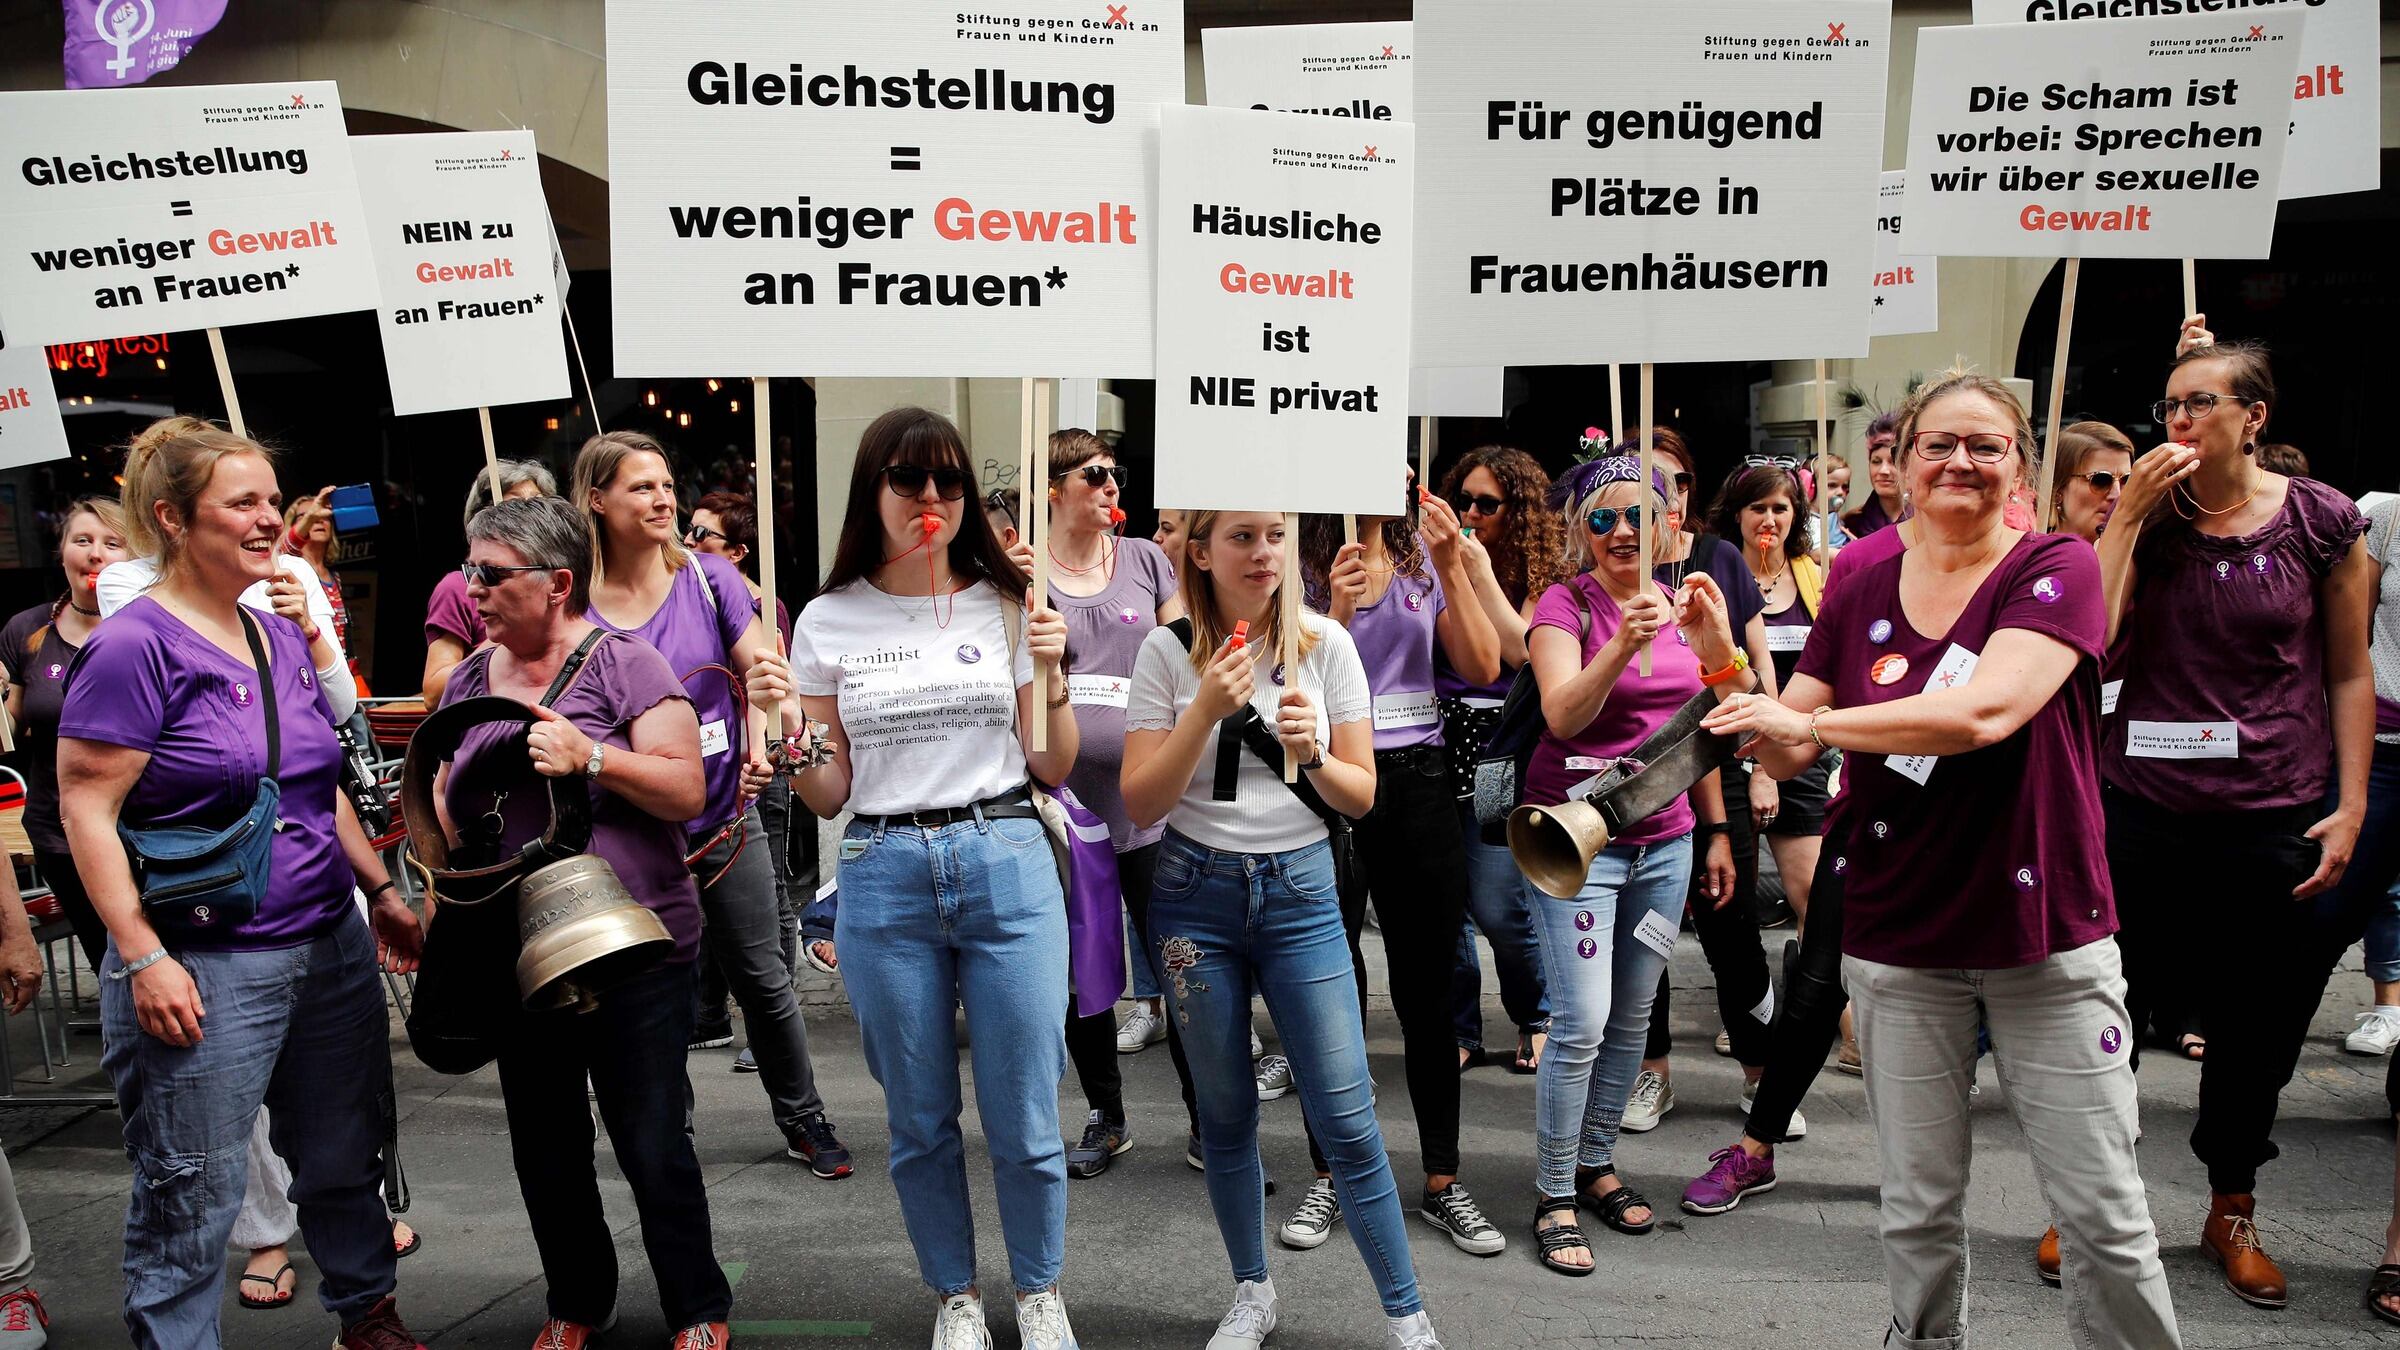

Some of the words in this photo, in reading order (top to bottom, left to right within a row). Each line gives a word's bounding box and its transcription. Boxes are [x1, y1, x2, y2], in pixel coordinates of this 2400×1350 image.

[957, 14, 1020, 27] Stiftung
[1028, 19, 1073, 29] gegen
[160, 41, 179, 54] jui
[957, 29, 1010, 40] Frauen
[1019, 33, 1045, 41] und
[1054, 33, 1113, 44] Kindern
[1705, 36, 1756, 47] Stiftung
[1763, 39, 1800, 48] gegen
[1705, 51, 1748, 60] Frauen
[1755, 51, 1776, 60] und
[1783, 52, 1831, 60] Kindern
[688, 61, 1114, 124] Gleichstellung
[1969, 86, 2028, 112] Die
[2042, 83, 2171, 110] Scham
[2187, 79, 2238, 106] ist
[1488, 101, 1570, 140] Für
[1587, 102, 1822, 148] genügend
[1937, 125, 2061, 152] vorbei:
[2075, 121, 2262, 155] Sprechen
[891, 147, 920, 170] =
[1273, 148, 1311, 158] Stiftung
[1273, 158, 1305, 166] Frauen
[1332, 163, 1368, 171] Kindern
[22, 147, 307, 186] Gleichstellung
[1931, 166, 1987, 191] wir
[1999, 166, 2084, 191] über
[2096, 163, 2259, 190] sexuelle
[171, 201, 192, 216] =
[1552, 178, 1700, 216] Plätze
[1719, 177, 1758, 214] in
[669, 196, 913, 248] weniger
[934, 198, 1136, 244] Gewalt
[1193, 204, 1381, 244] Häusliche
[2020, 205, 2151, 231] Gewalt
[403, 221, 472, 244] NEIN
[482, 224, 513, 239] zu
[31, 238, 195, 271] weniger
[208, 222, 337, 256] Gewalt
[417, 258, 514, 283] Gewalt
[1220, 263, 1353, 299] Gewalt
[1471, 253, 1827, 293] Frauenhäusern
[95, 286, 143, 308] an
[744, 273, 813, 305] an
[395, 308, 428, 324] an
[1263, 323, 1309, 353] ist
[1191, 376, 1255, 407] NIE
[1270, 382, 1378, 414] privat
[858, 690, 890, 702] person
[894, 687, 915, 695] who
[918, 681, 959, 693] believes
[976, 680, 990, 688] the
[879, 699, 899, 710] and
[903, 695, 952, 707] economic
[956, 692, 995, 704] equality
[879, 711, 931, 723] regardless
[934, 707, 945, 716] of
[947, 707, 971, 716] race,
[913, 721, 939, 732] class,
[942, 719, 982, 730] religion,
[896, 733, 951, 745] orientation.
